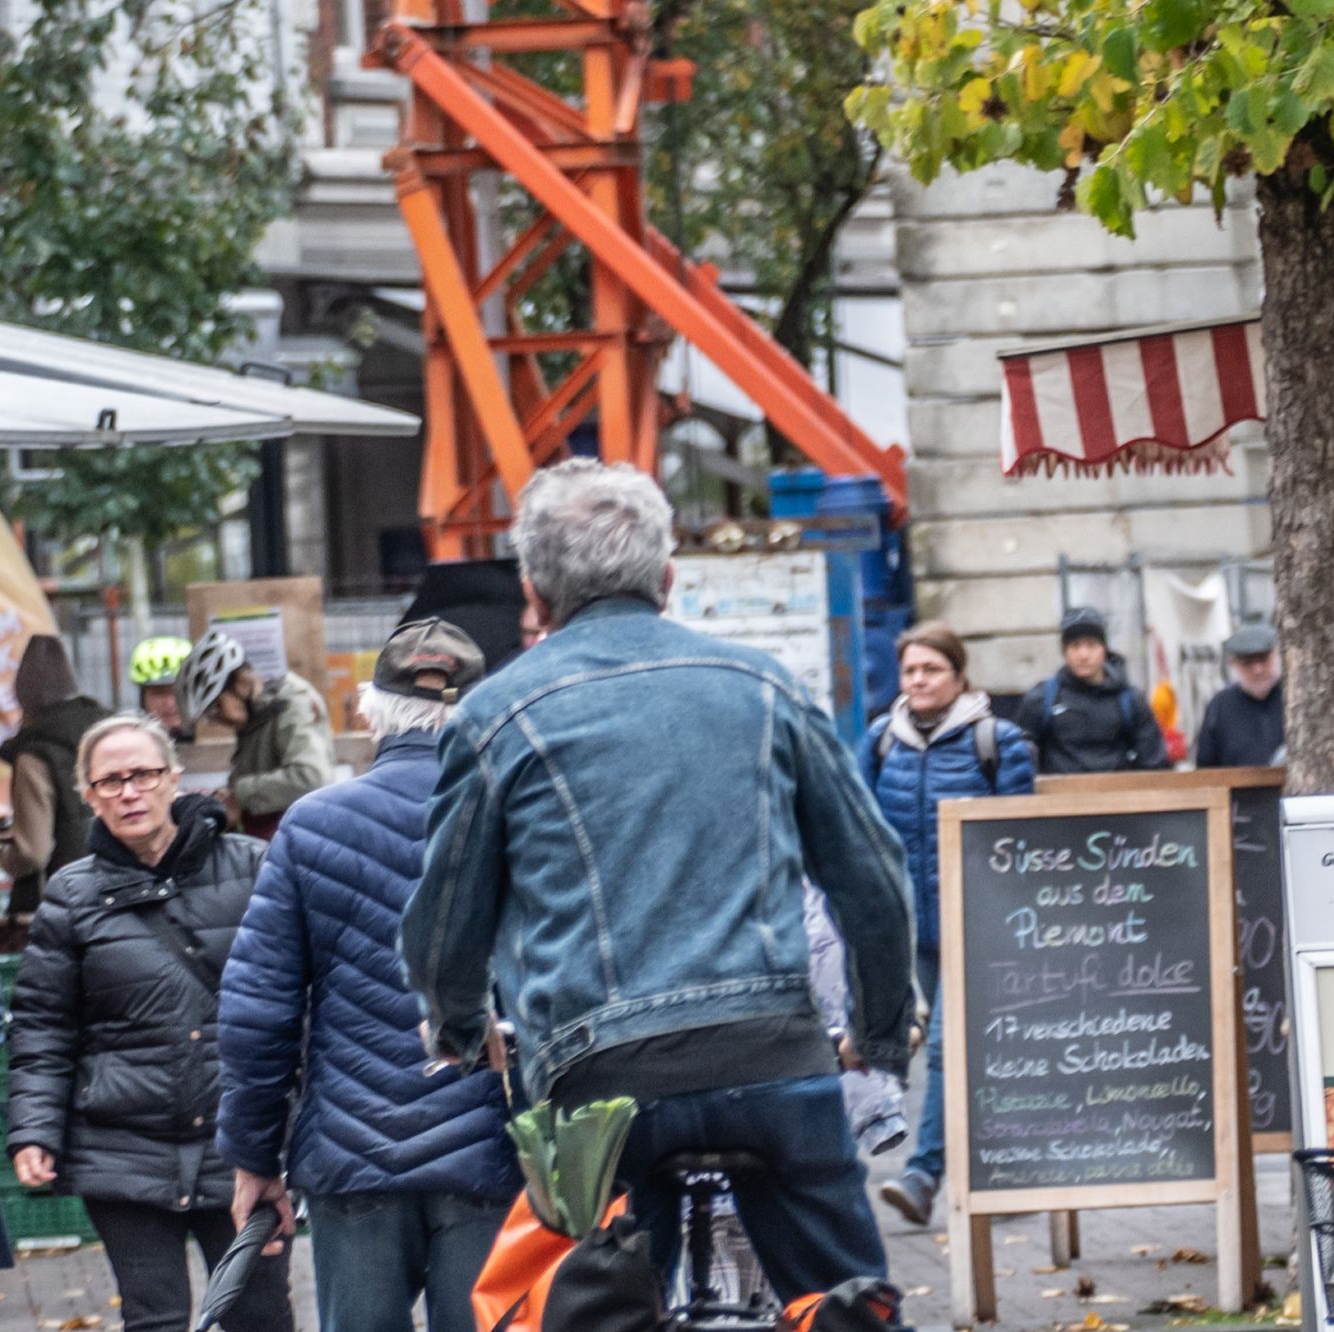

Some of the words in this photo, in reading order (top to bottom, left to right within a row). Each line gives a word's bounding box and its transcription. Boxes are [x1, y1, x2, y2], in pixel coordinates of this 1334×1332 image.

[1076, 831, 1198, 871] Sünden
[1036, 883, 1084, 906] aus
[1092, 873, 1155, 905] dem
[1005, 906, 1148, 949] Piemont
[989, 952, 1107, 1003] Tartufi
[1119, 951, 1195, 988] dolce
[1022, 1008, 1173, 1041] verschiedene
[985, 1053, 1050, 1079] kleine
